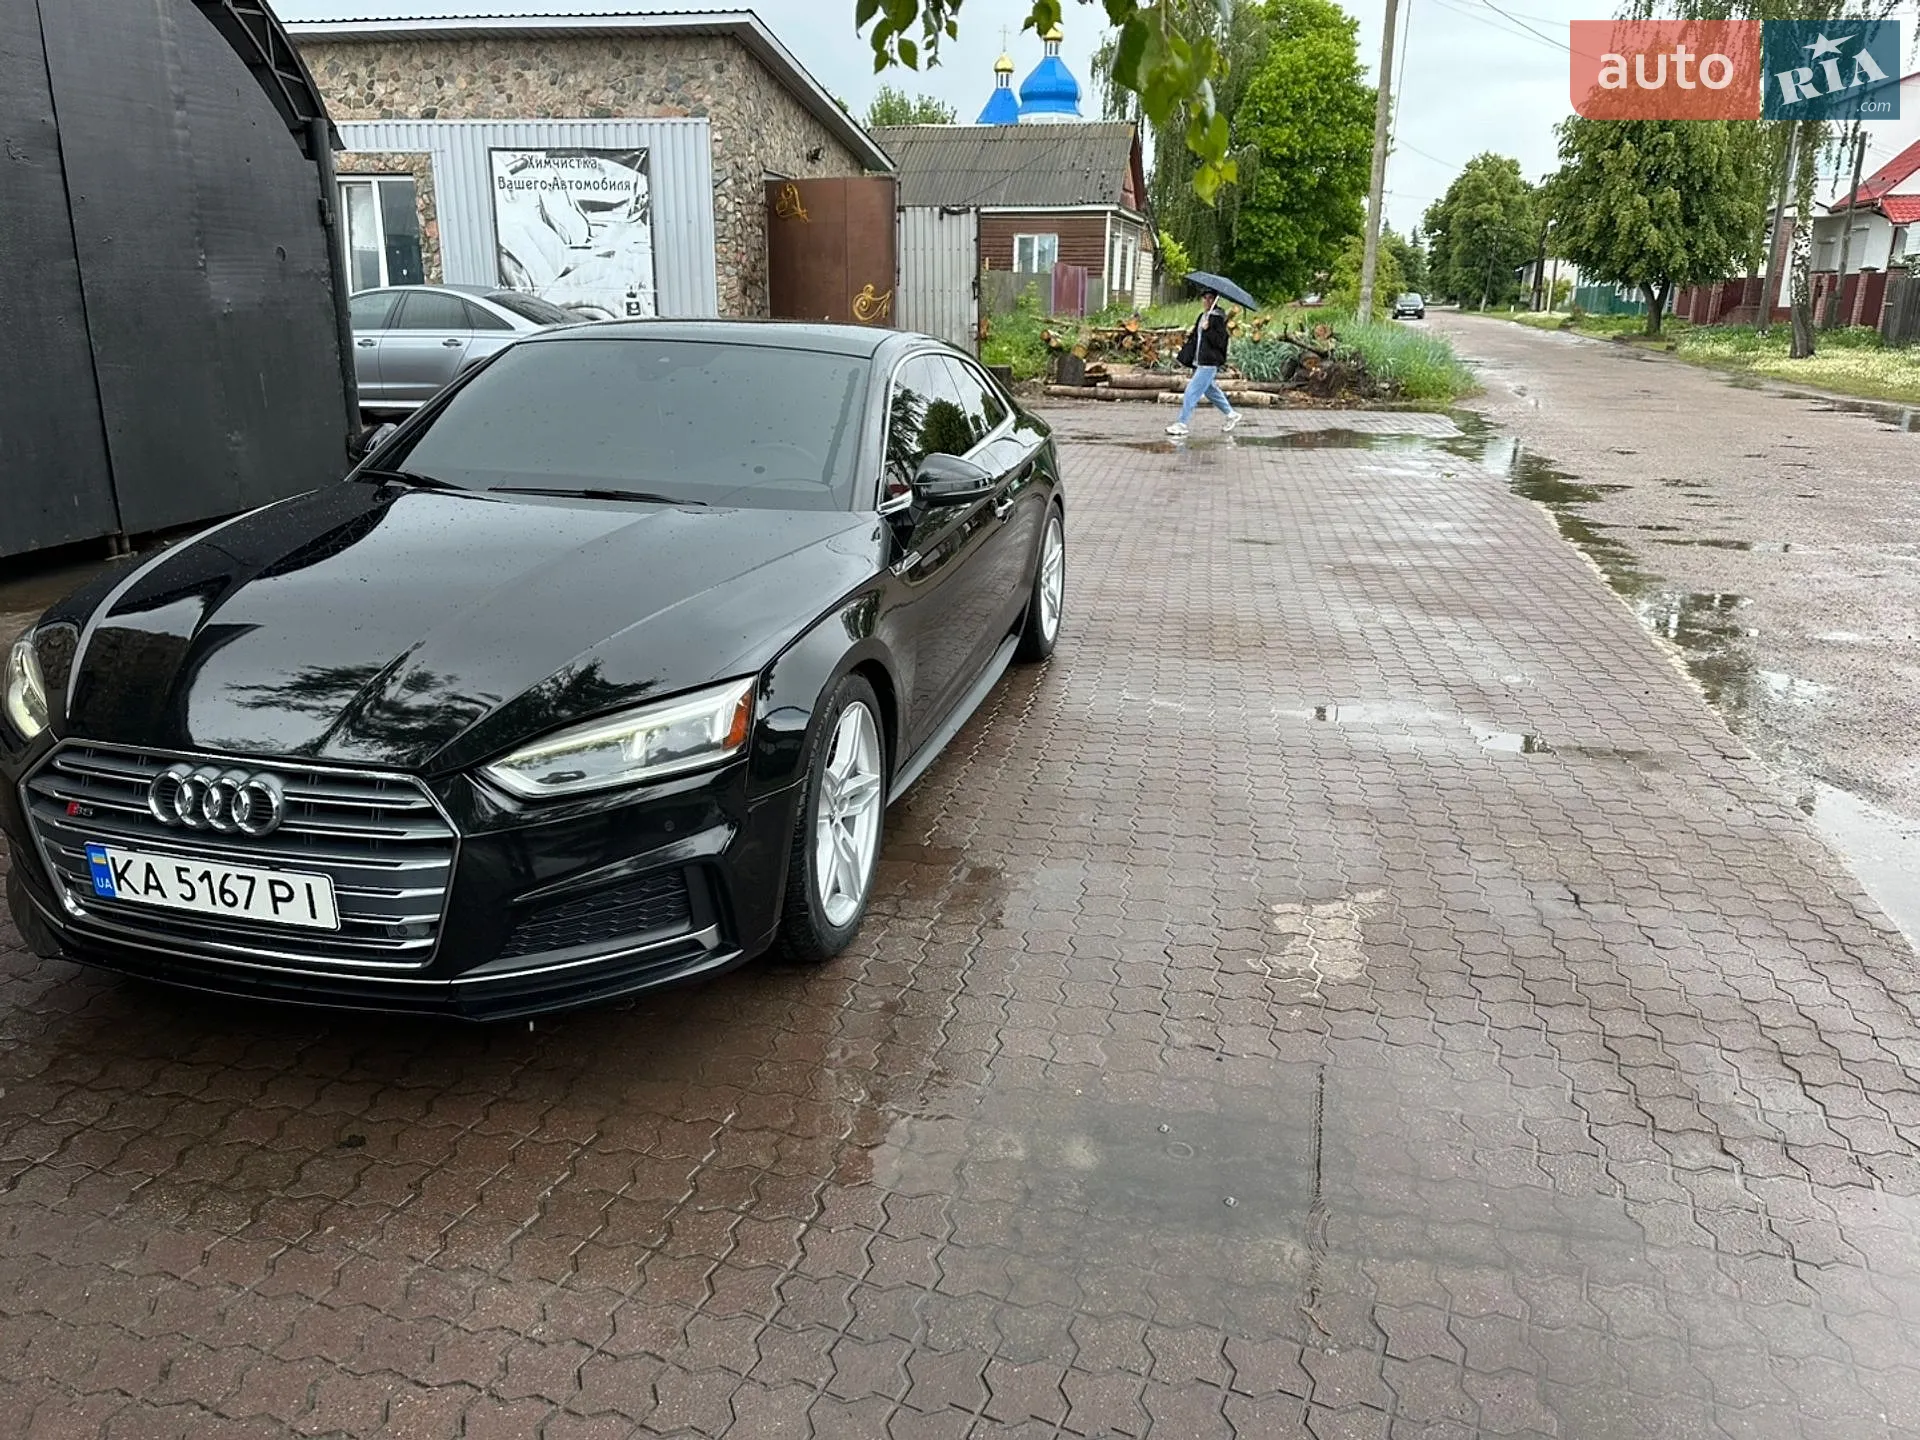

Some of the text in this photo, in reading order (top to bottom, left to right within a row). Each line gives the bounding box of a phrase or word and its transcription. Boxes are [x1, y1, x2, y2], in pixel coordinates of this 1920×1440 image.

[527, 155, 597, 169] Химчистка
[498, 176, 548, 190] Вашего
[552, 176, 631, 191] Автомобиля
[96, 876, 113, 890] UA
[110, 856, 318, 920] KA 5167 PI
